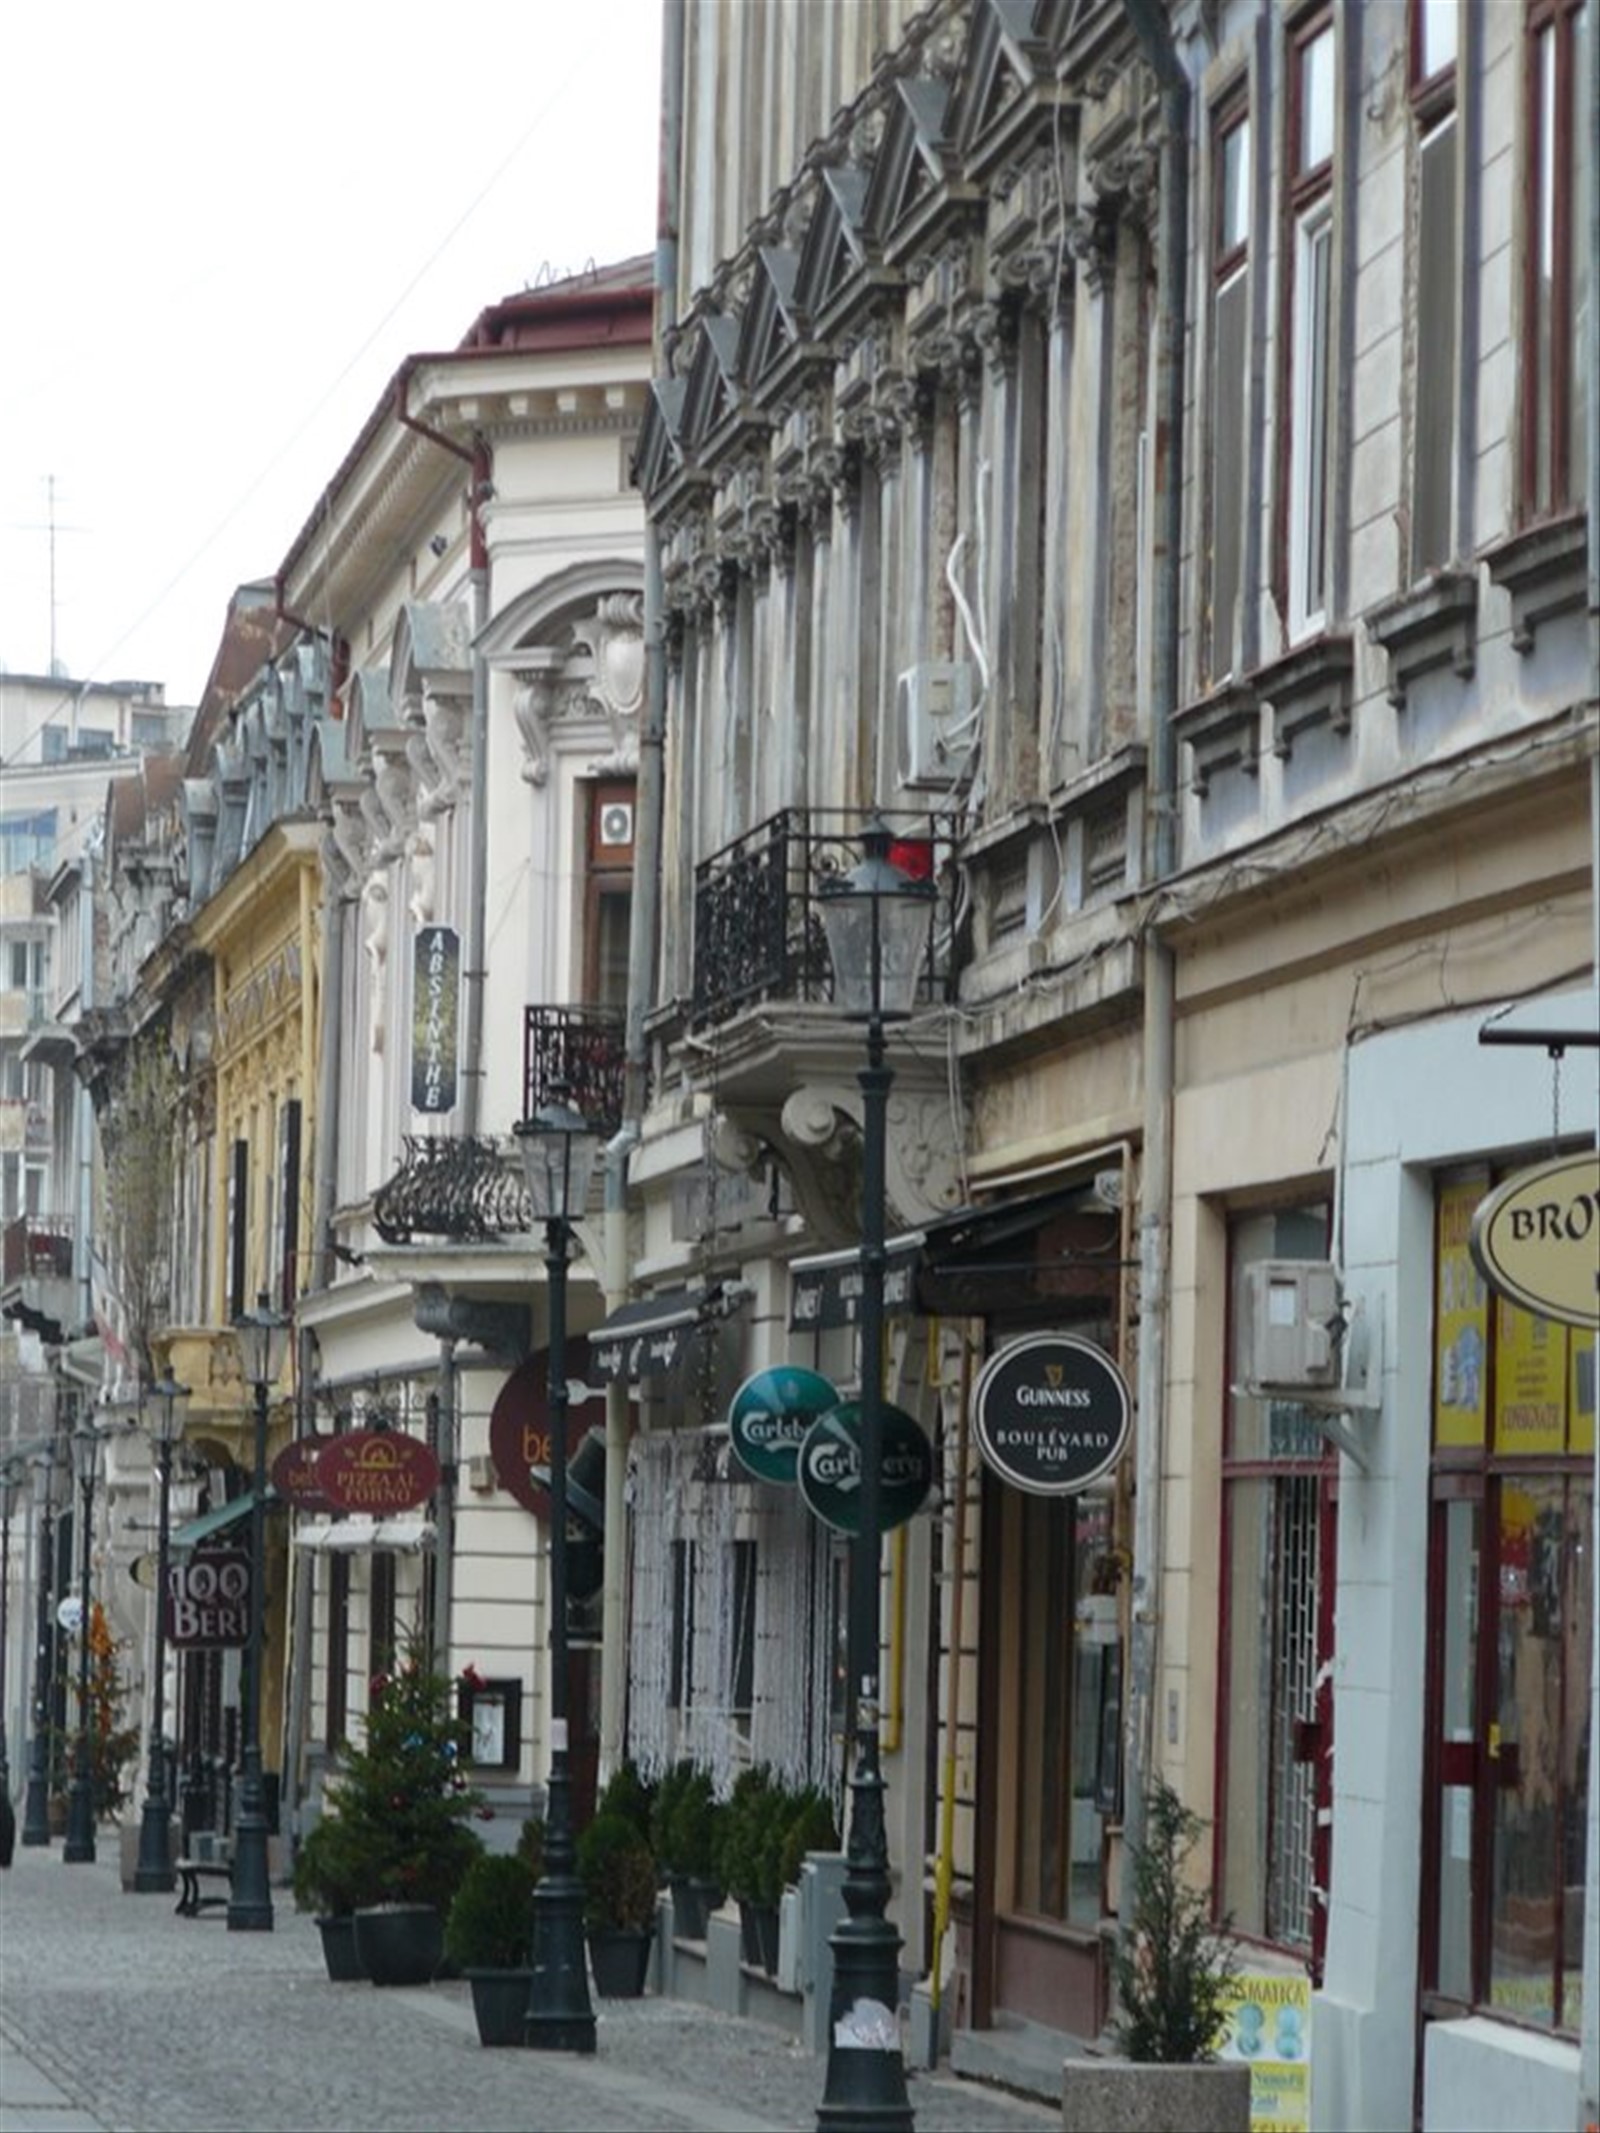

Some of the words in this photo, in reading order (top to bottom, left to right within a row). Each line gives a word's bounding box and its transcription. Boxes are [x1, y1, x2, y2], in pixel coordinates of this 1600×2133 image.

[425, 930, 444, 1109] ABSINTHE
[1510, 1192, 1598, 1241] BRO
[1016, 1384, 1091, 1406] GUINNESS
[522, 1425, 551, 1463] be
[741, 1411, 808, 1446] Carlsb
[996, 1428, 1109, 1448] BOULÉVARD
[808, 1443, 922, 1485] Carlerg
[1037, 1447, 1068, 1461] PUB
[336, 1471, 391, 1487] PIZZA
[345, 1487, 411, 1503] FORNO
[167, 1562, 249, 1602] 100
